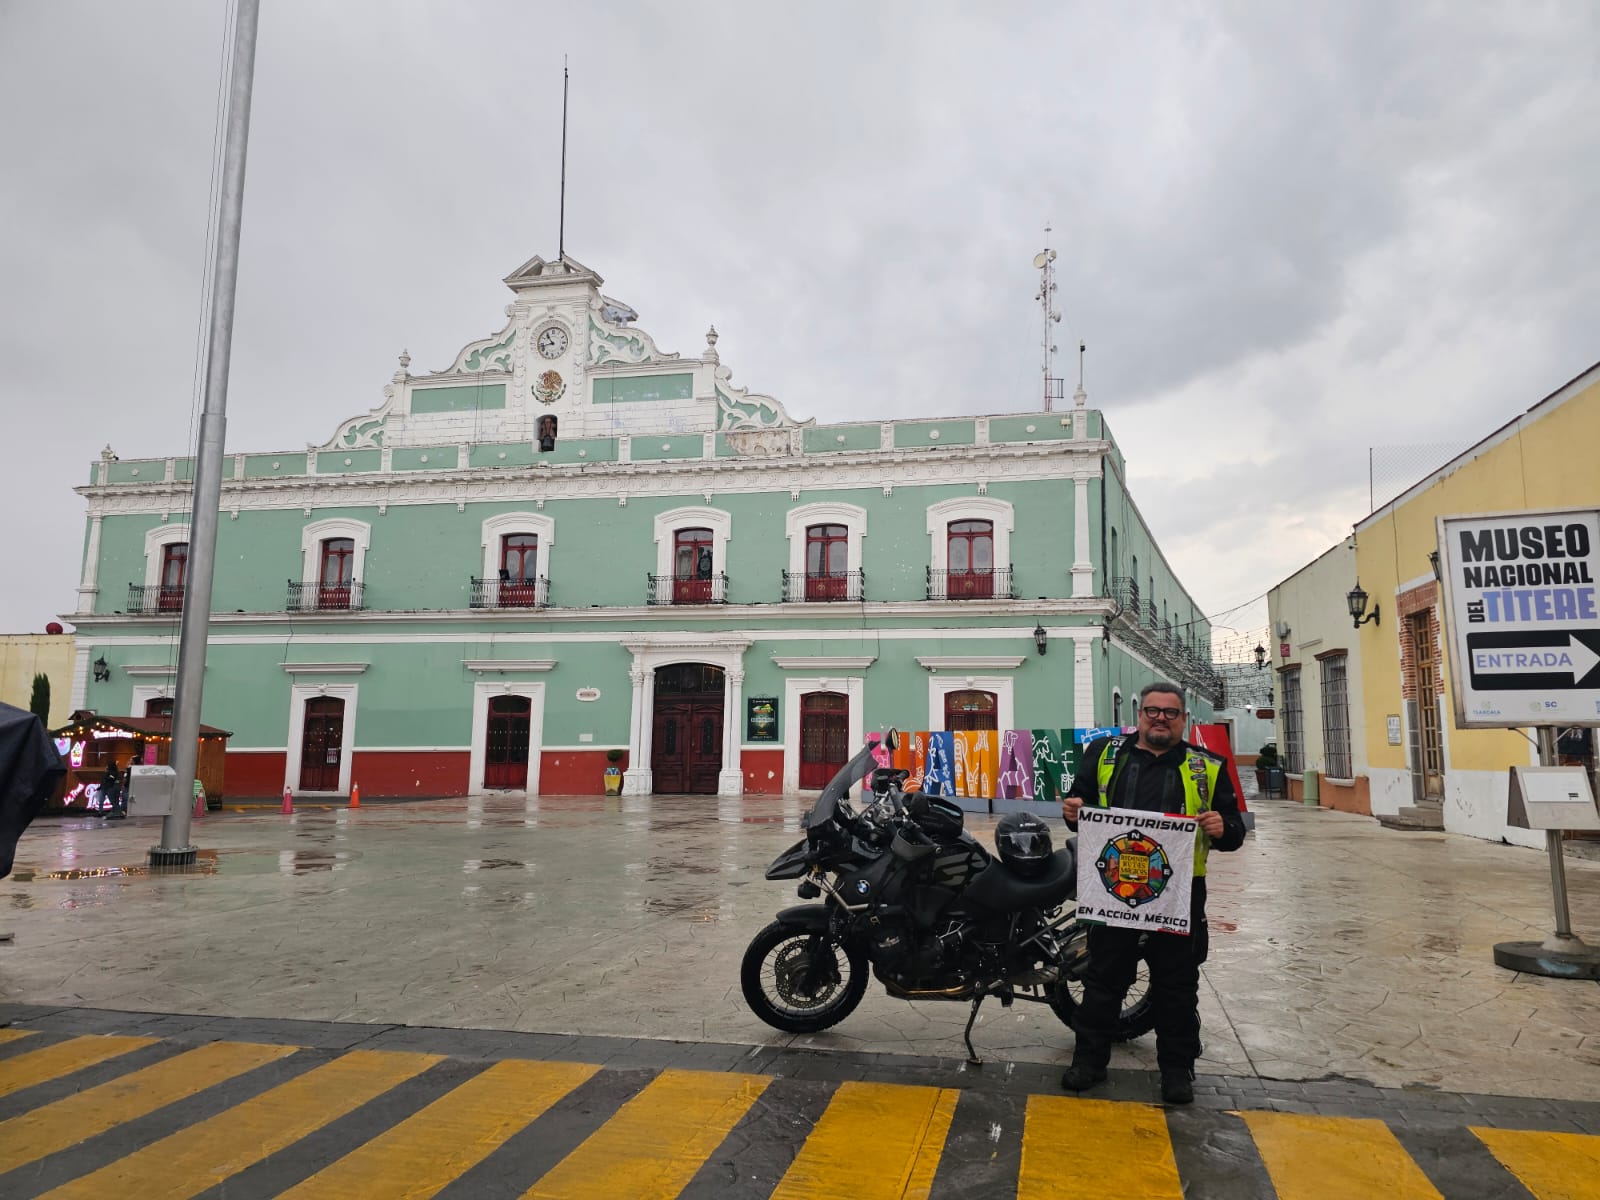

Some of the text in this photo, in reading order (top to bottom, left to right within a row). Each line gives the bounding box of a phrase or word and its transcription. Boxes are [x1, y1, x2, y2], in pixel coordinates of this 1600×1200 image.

[1460, 524, 1590, 562] MUSEO
[1463, 561, 1594, 588] NACIONAL
[1467, 599, 1485, 623] DEL
[1476, 653, 1573, 668] ENTRADA
[1079, 810, 1196, 832] MOTOTURISMO
[1078, 906, 1188, 928] EN ACCIÓN MÉXICO
